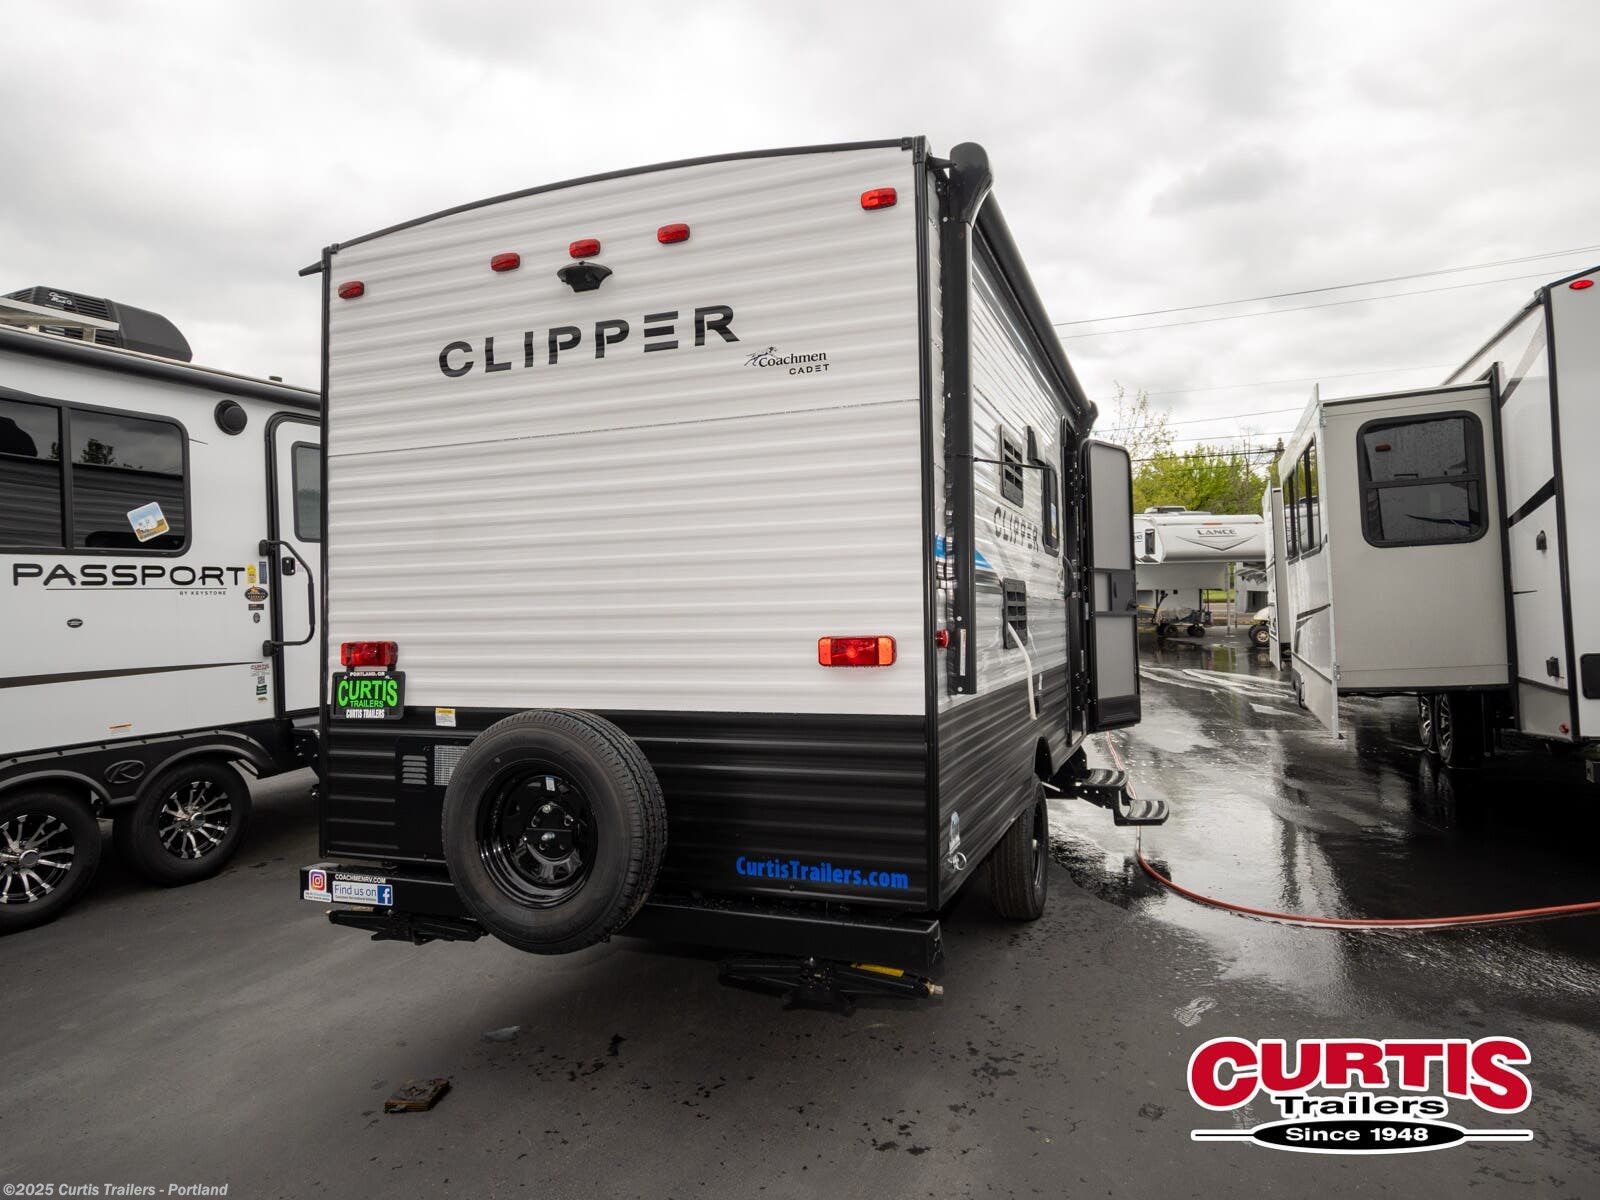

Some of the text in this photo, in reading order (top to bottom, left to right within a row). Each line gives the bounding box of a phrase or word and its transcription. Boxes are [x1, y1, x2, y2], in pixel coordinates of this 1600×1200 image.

[438, 304, 740, 378] CLIPPER
[758, 352, 827, 368] Coachmen
[789, 364, 830, 375] CADET
[993, 506, 1039, 552] CLIPPER
[12, 563, 246, 586] PASSPORT
[338, 680, 398, 707] CURTIS
[350, 700, 384, 708] TRAILERS
[346, 709, 385, 719] CURTIS TRAILERS
[334, 873, 387, 884] COACHMENRV.COM
[735, 855, 909, 889] CurtisTrailers.com
[334, 884, 353, 895] Find
[354, 888, 364, 897] us
[365, 888, 377, 897] on
